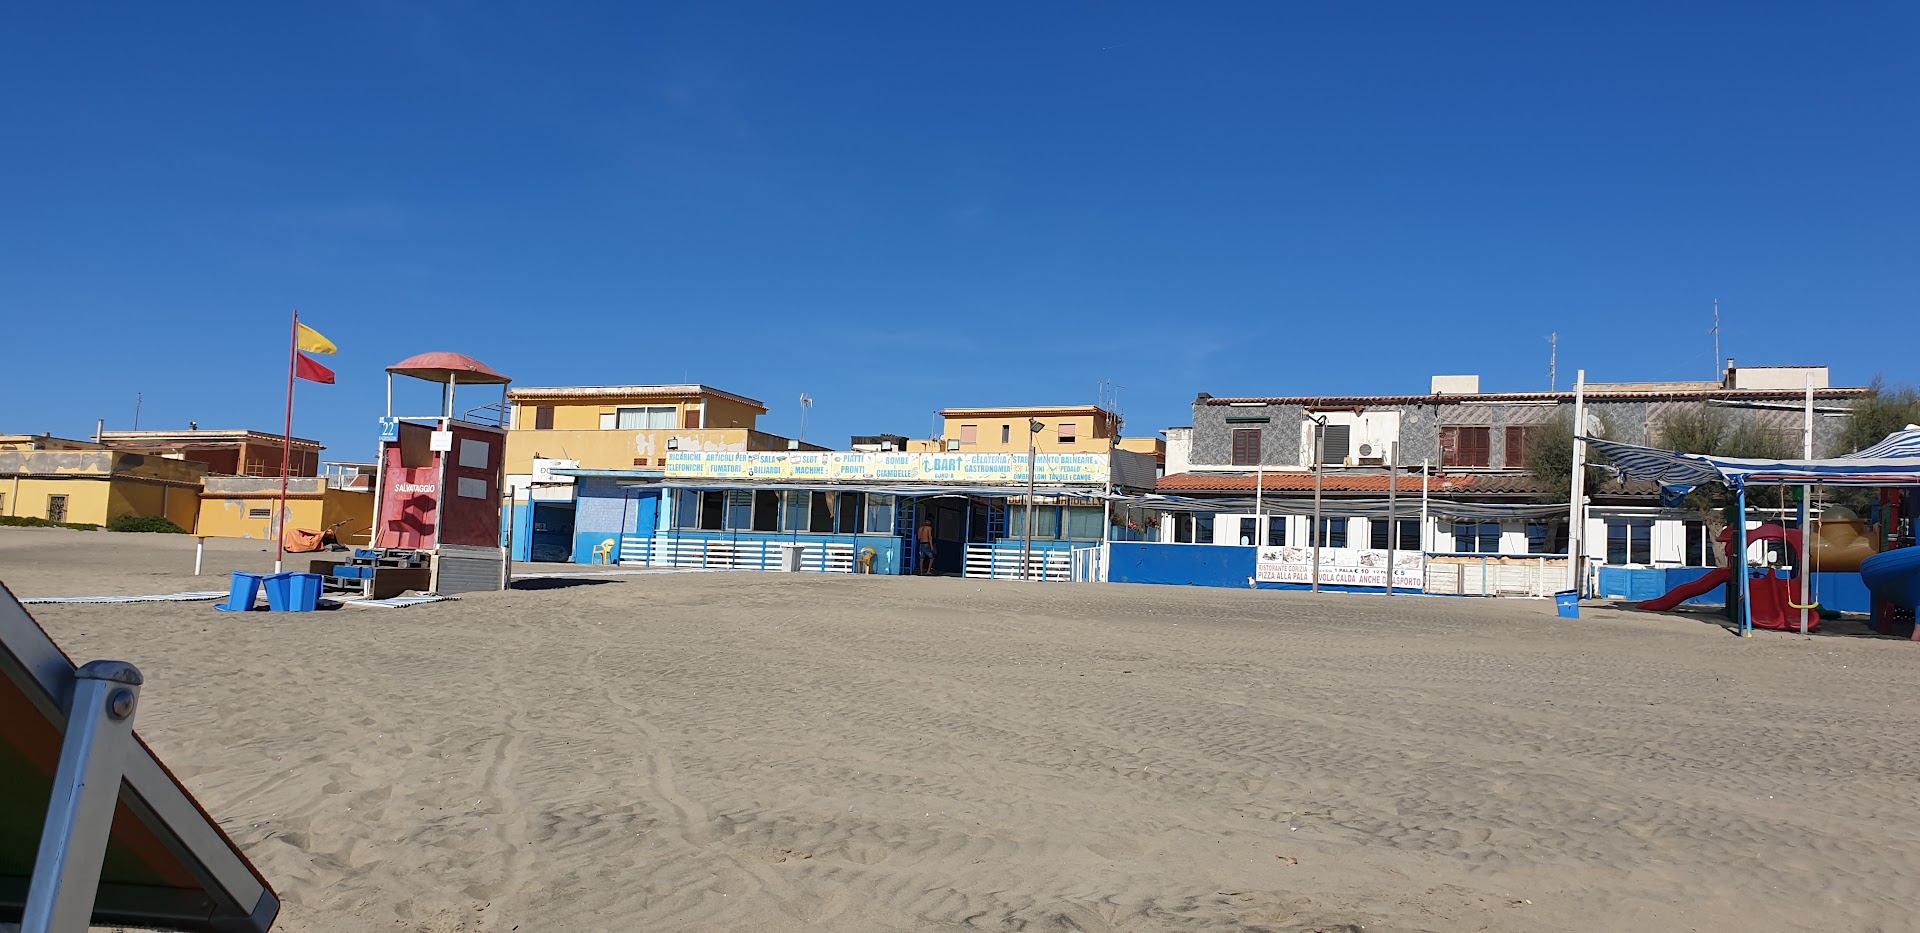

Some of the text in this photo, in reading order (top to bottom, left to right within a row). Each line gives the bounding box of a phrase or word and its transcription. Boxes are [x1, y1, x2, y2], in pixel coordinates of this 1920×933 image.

[382, 422, 394, 435] 22
[669, 453, 702, 461] RICARICHE
[706, 454, 734, 462] ARTICOLI
[760, 455, 776, 464] SALA
[802, 455, 818, 464] SLOT
[843, 455, 864, 463] PIATTI
[885, 456, 909, 465] BOMBE
[971, 455, 1007, 464] GELATERIA
[1060, 456, 1094, 464] BALNEARE
[667, 463, 704, 472] TELEFONICHE
[710, 464, 742, 473] FUMATORI
[933, 458, 956, 471] BAR
[964, 465, 1011, 473] GASTRONOMIA
[753, 466, 781, 474] BILIARDI
[794, 466, 824, 475] MACHINE
[840, 465, 865, 474] PRONTI
[876, 469, 911, 478] CIAMBELLE
[394, 483, 435, 493] SALVATAGGIO
[1258, 564, 1287, 572] RISTORANTE
[1257, 571, 1275, 580] PIZZA
[1276, 573, 1292, 581] ALLA
[1292, 573, 1308, 581] PALA
[1335, 574, 1356, 583] CALDA
[1359, 575, 1381, 584] ANCHE
